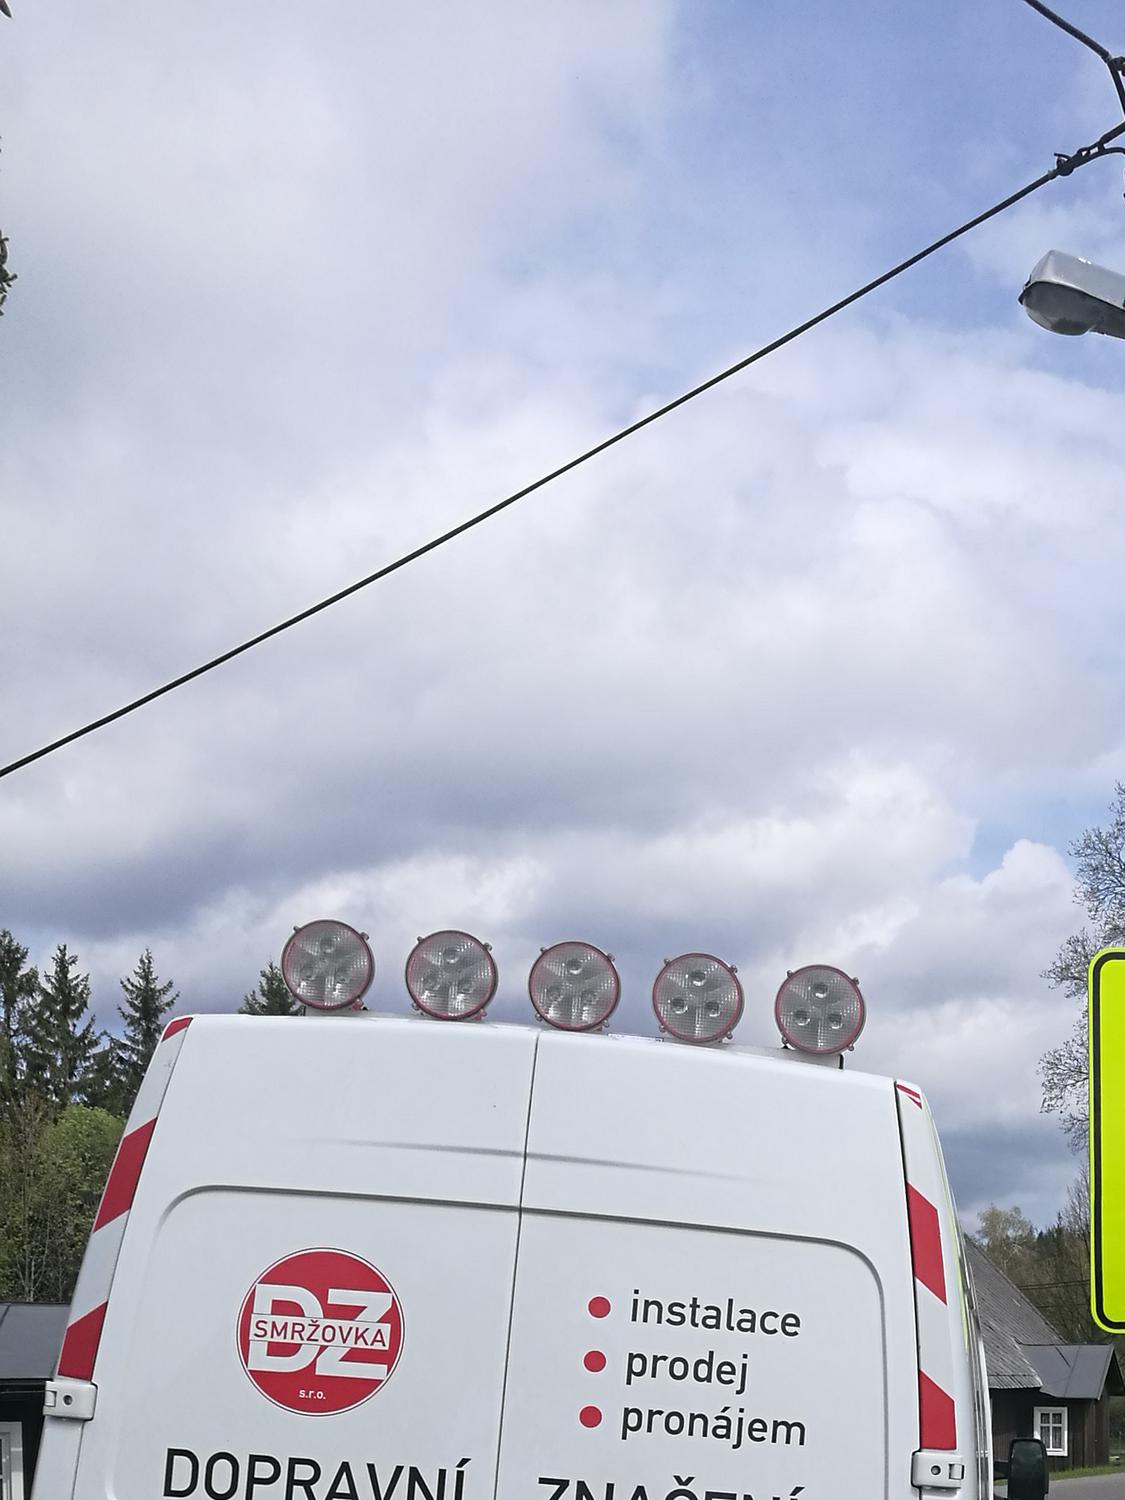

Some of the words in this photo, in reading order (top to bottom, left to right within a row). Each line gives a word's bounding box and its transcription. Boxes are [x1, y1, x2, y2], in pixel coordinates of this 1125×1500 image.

[253, 1319, 387, 1348] SMRŽOVKA
[631, 1288, 801, 1337] instalace
[298, 1389, 327, 1400] s.r.o.
[625, 1350, 748, 1395] prodej
[621, 1406, 806, 1450] pronájem
